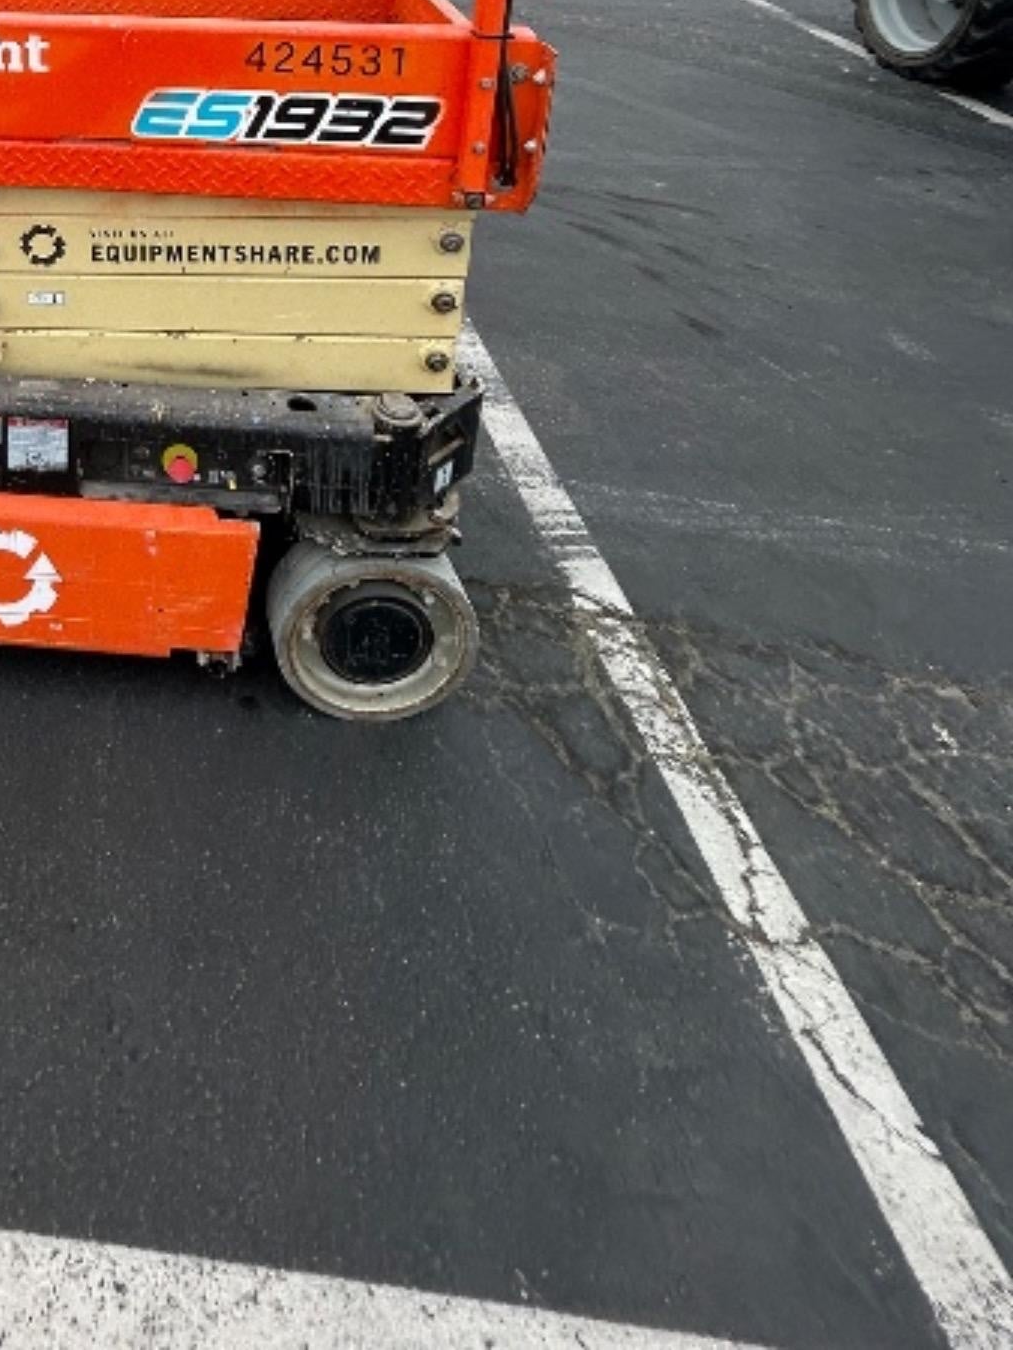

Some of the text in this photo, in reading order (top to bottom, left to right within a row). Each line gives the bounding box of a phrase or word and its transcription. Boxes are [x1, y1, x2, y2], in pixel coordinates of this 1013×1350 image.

[244, 41, 407, 76] 424531
[132, 88, 444, 149] ES1932
[90, 244, 382, 265] EQUIPMENTSHARE.COM
